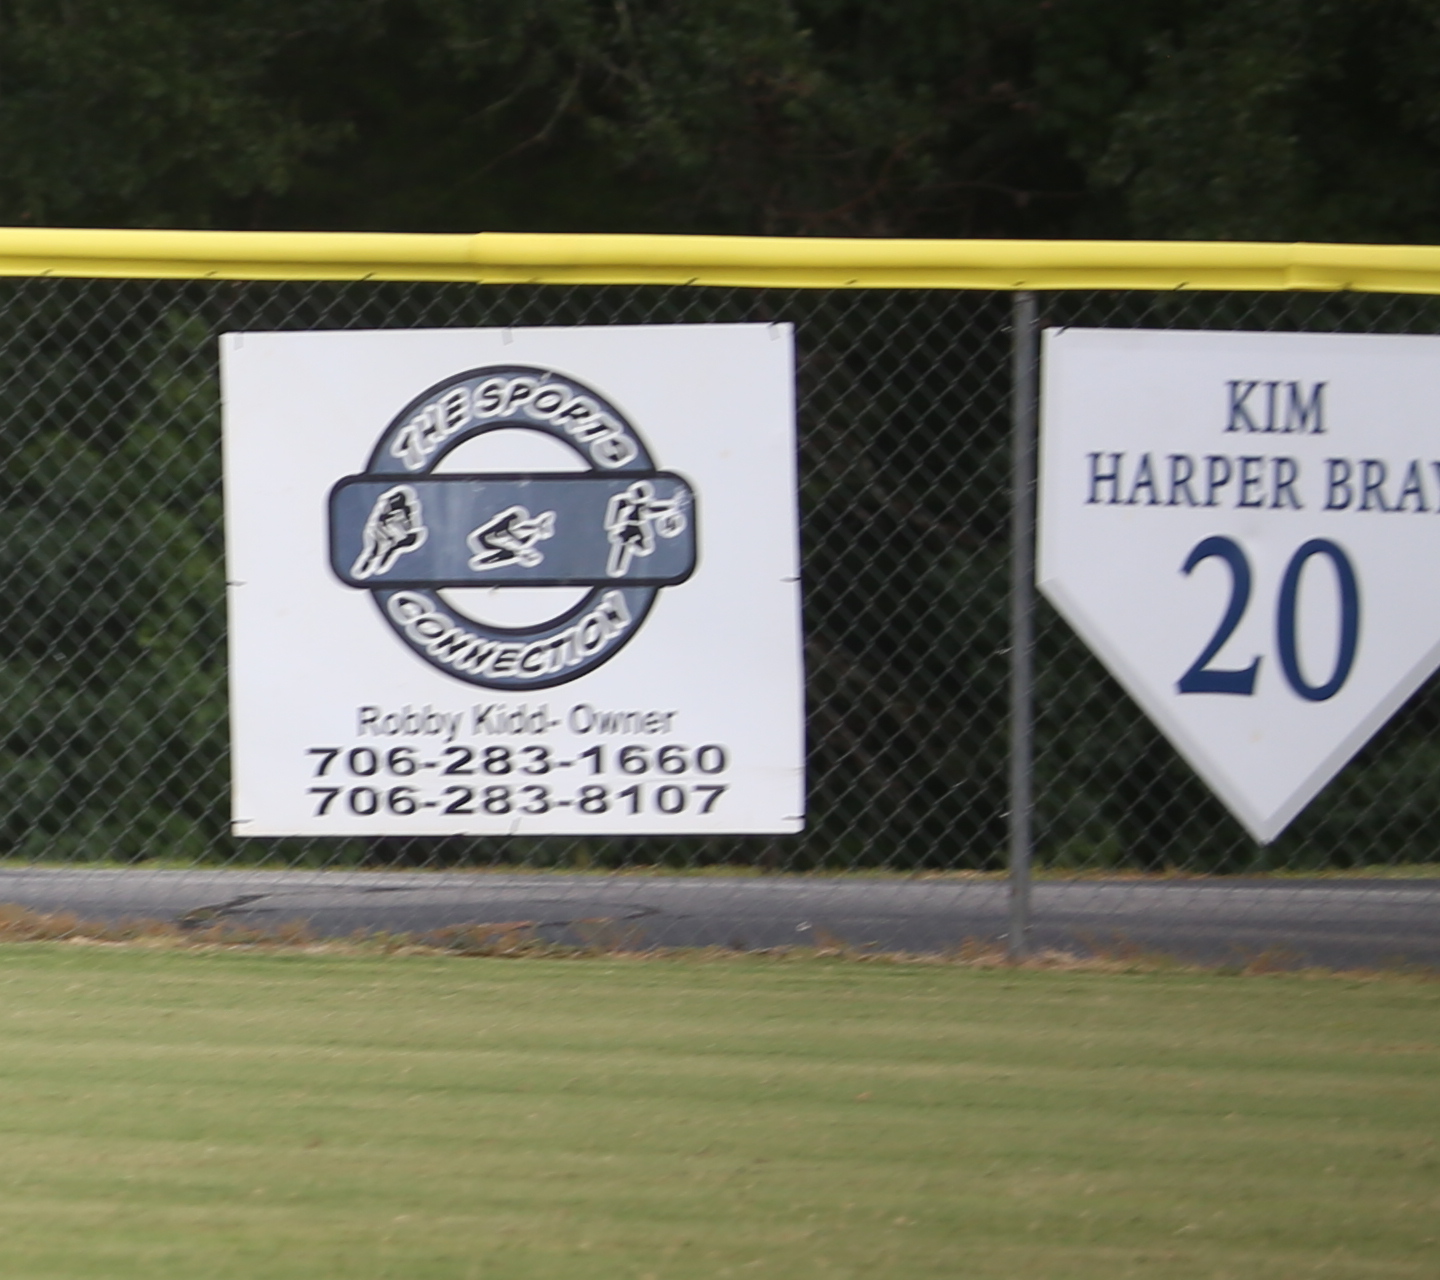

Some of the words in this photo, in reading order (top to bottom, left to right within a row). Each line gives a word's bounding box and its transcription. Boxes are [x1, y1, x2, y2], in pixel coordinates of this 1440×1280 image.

[389, 386, 473, 470] THE
[473, 376, 639, 470] SPORTS
[1223, 379, 1329, 434] KIM
[1084, 451, 1304, 511] HARPER
[1323, 457, 1440, 514] BRA
[387, 589, 632, 679] CONNECTION
[1175, 535, 1361, 703] 20
[356, 703, 461, 744] Robby
[568, 705, 678, 737] Owner
[306, 743, 729, 778] 706-283-1660
[306, 782, 730, 817] 706-283-8107
